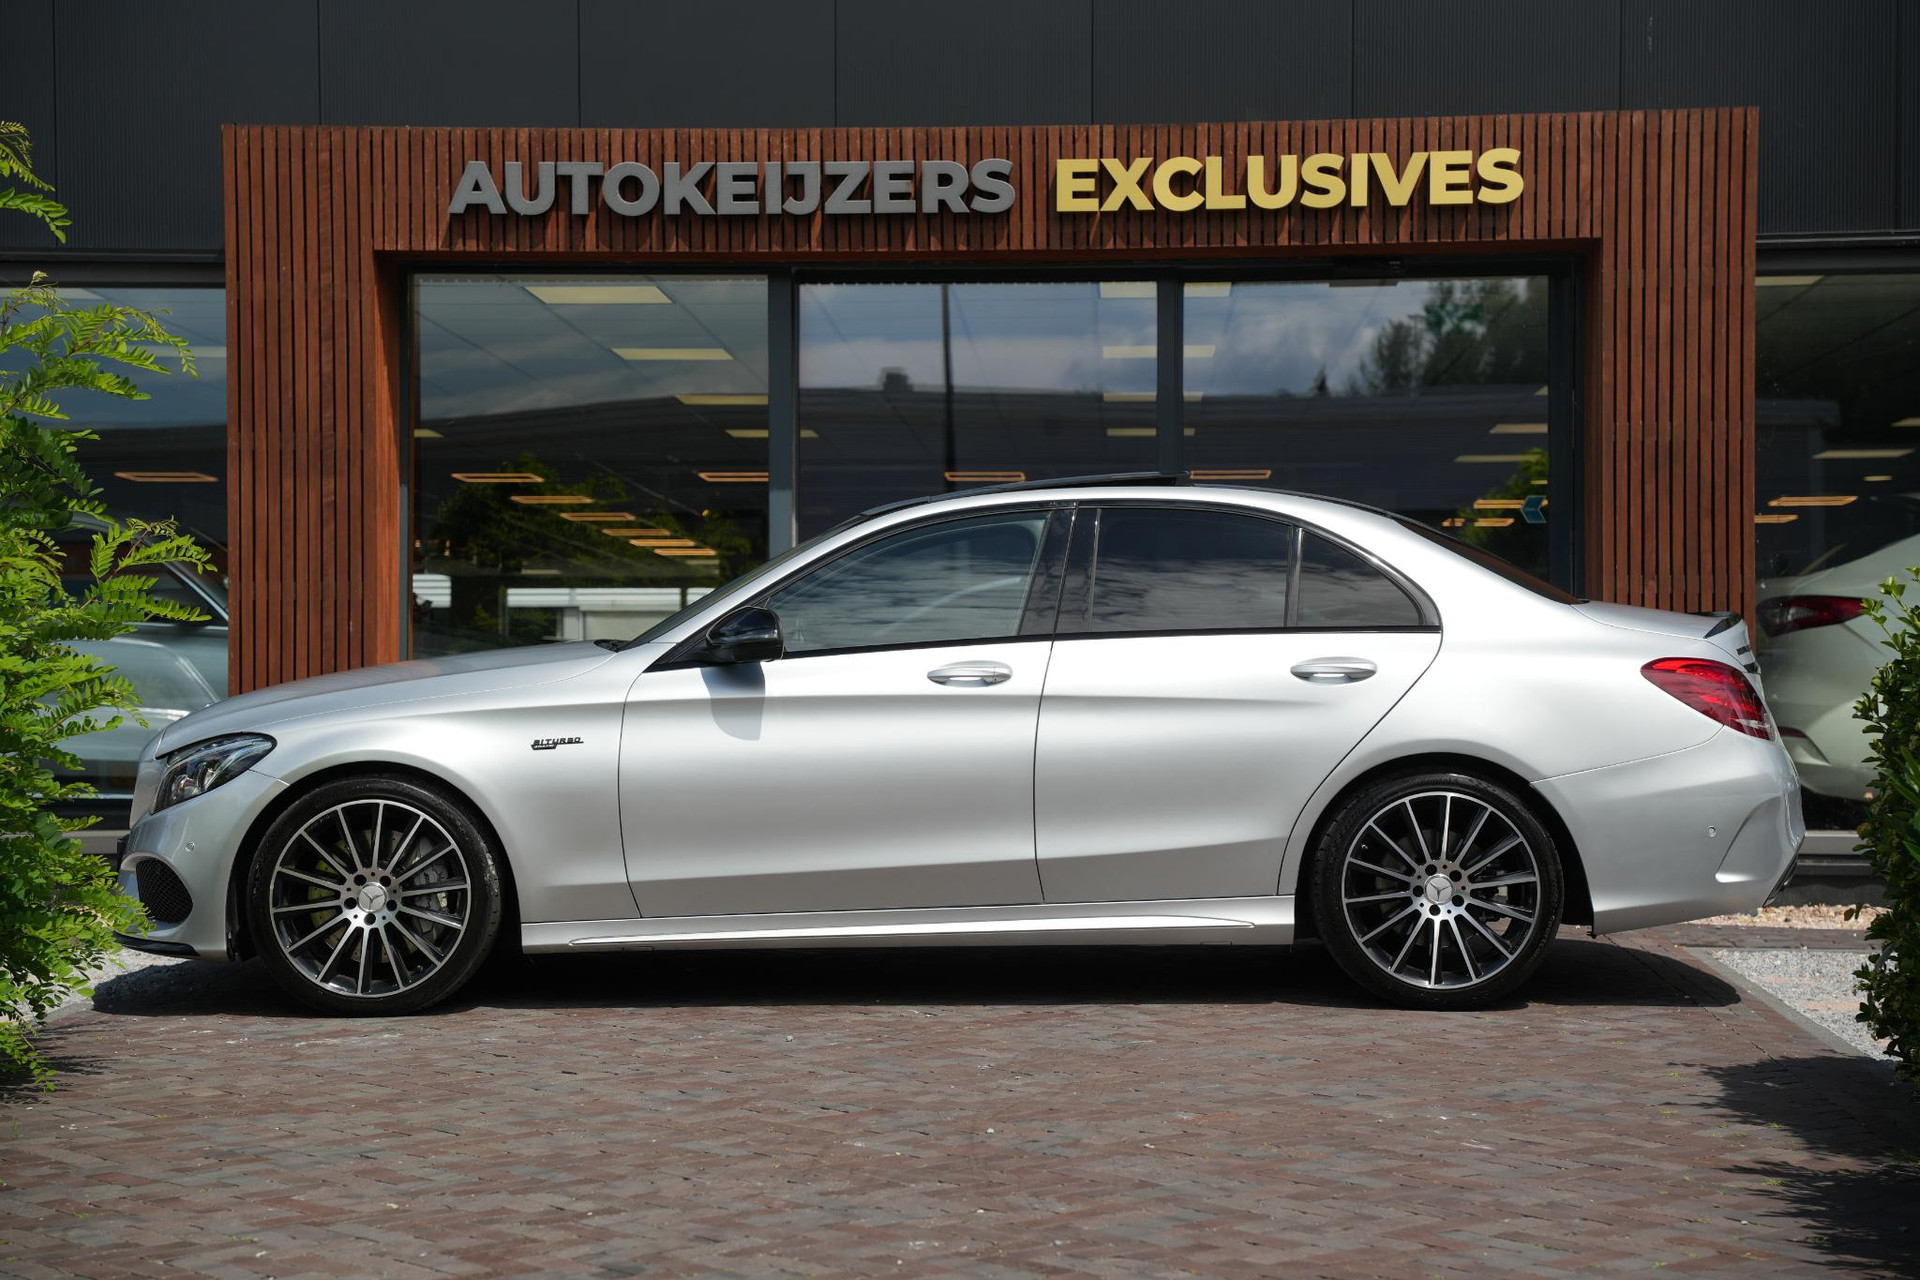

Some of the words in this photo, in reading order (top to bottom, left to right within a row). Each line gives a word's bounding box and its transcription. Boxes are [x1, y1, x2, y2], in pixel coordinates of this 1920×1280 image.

[448, 158, 1016, 217] AUTOKEIJZERS
[1056, 147, 1524, 213] EXCLUSIVES
[532, 736, 582, 745] BITURBO
